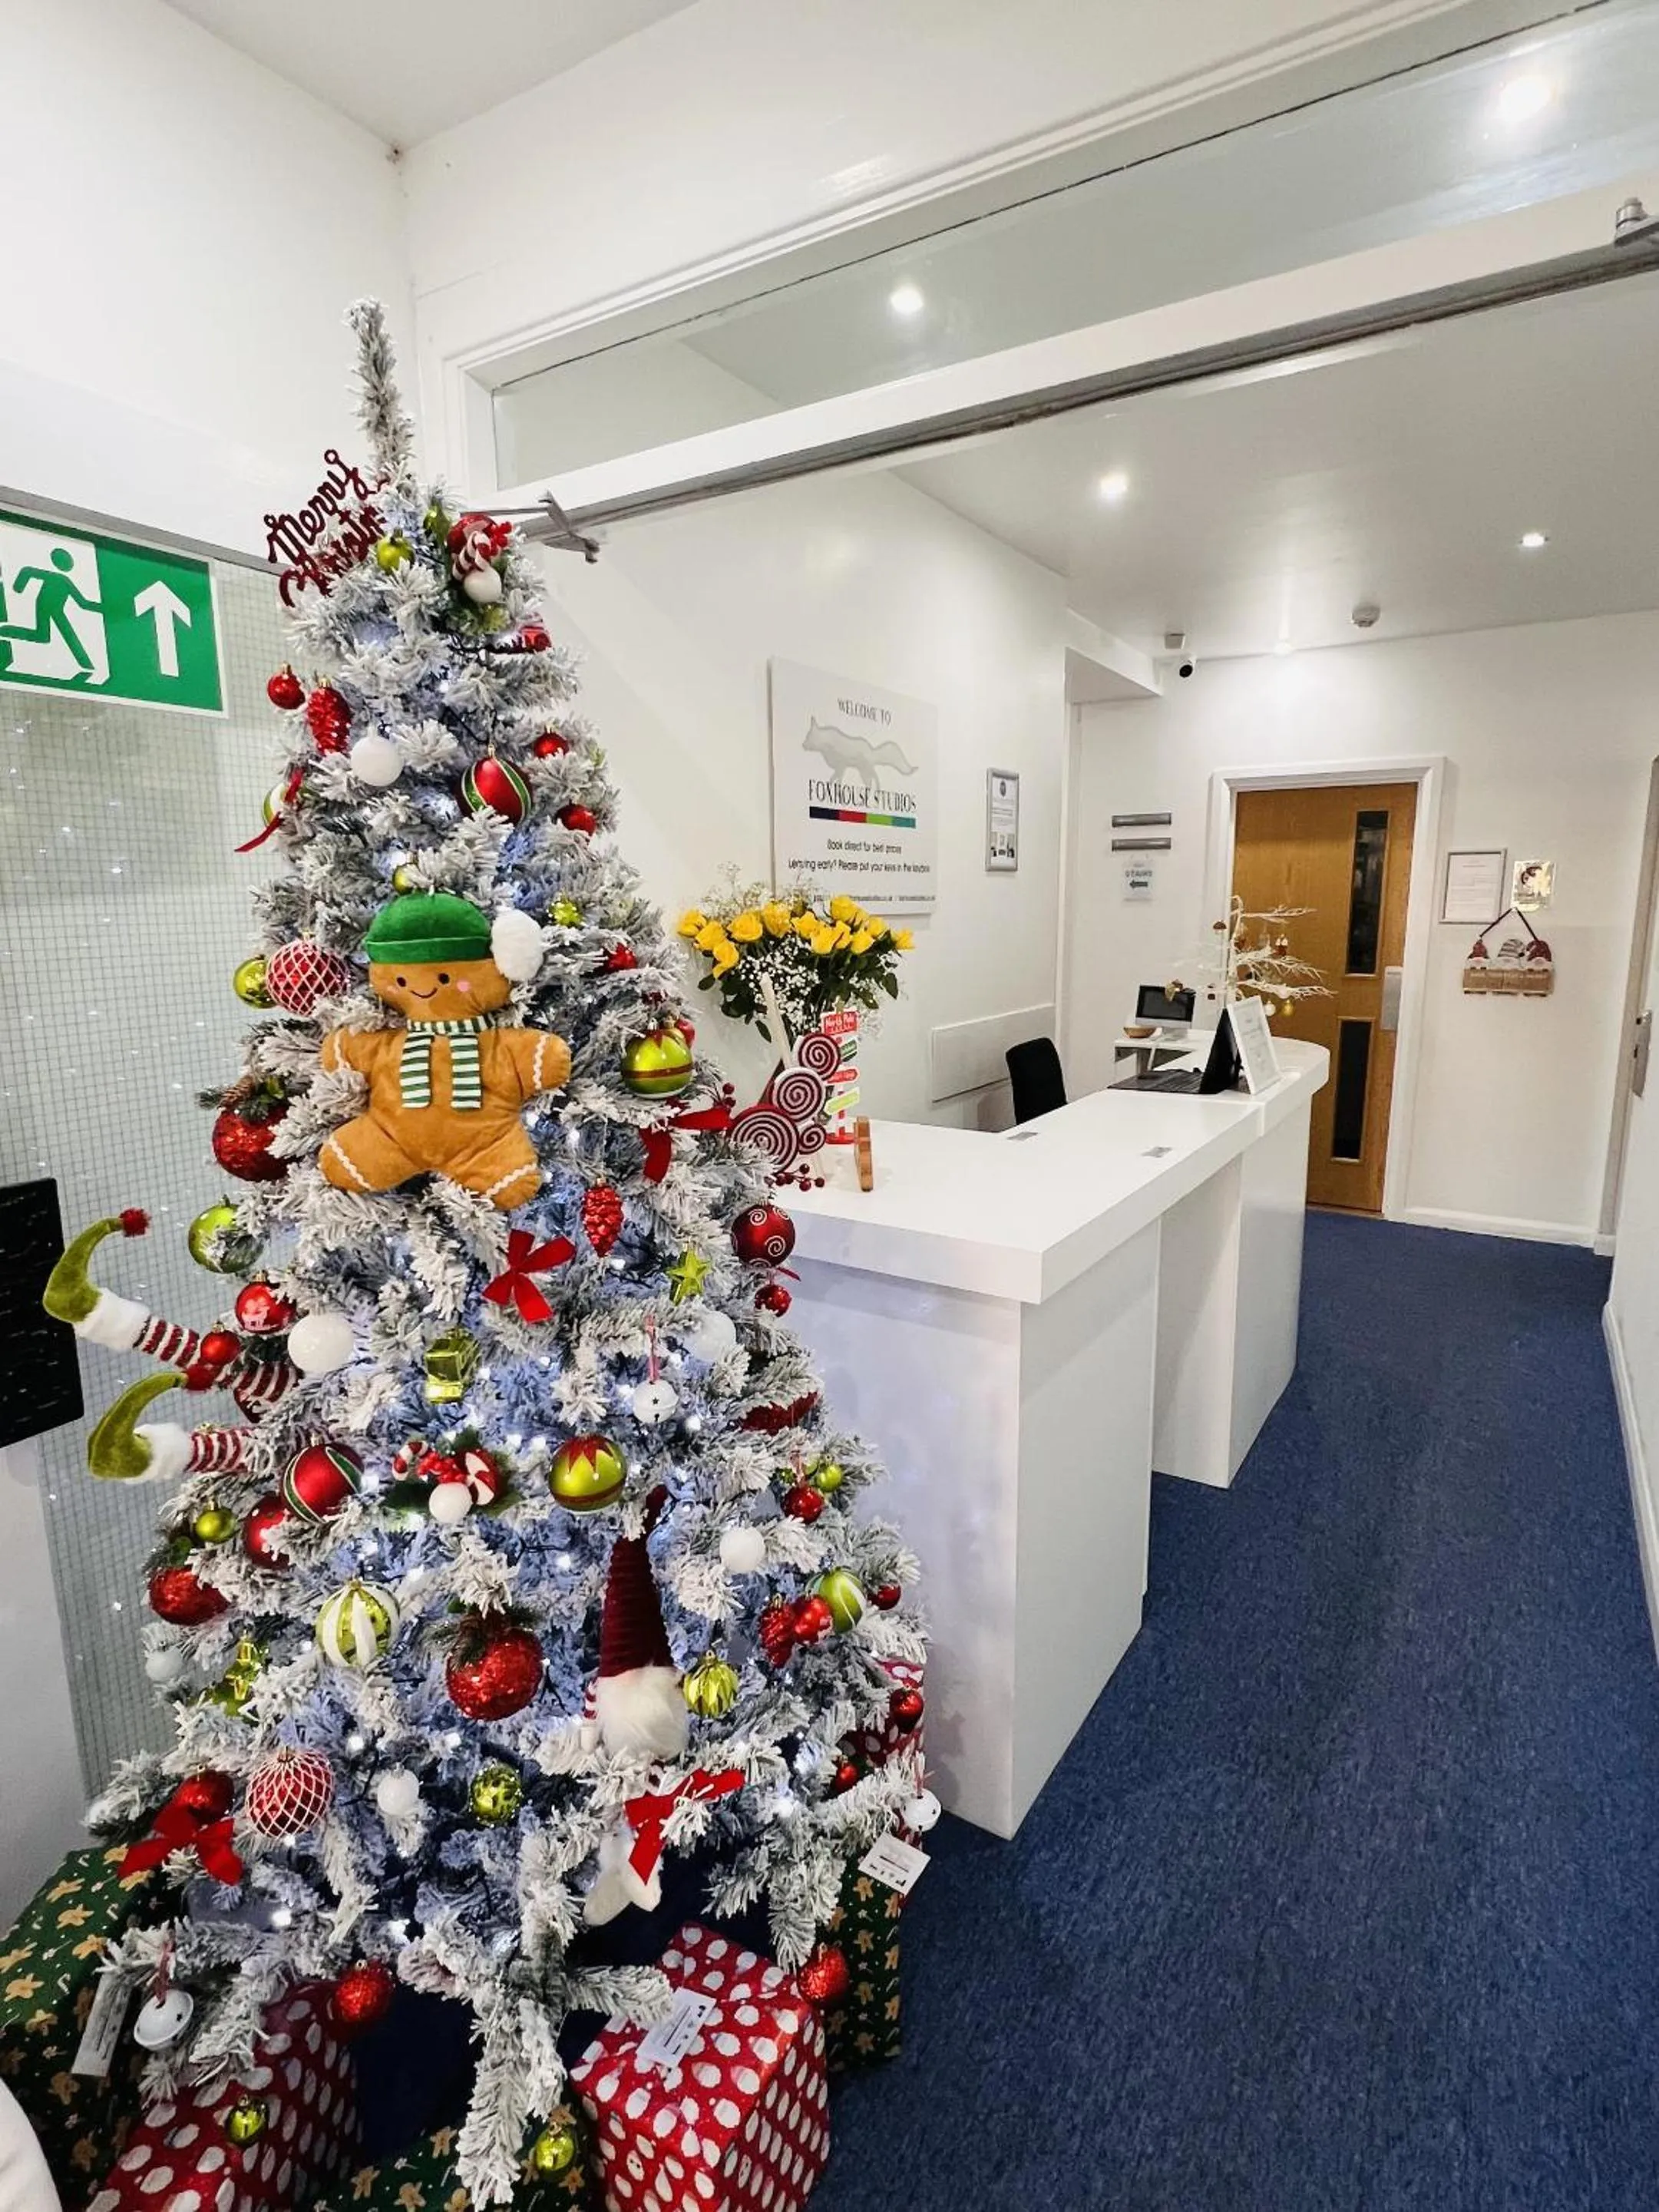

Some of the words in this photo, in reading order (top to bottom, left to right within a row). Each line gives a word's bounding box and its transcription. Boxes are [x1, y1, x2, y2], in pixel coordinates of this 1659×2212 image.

[837, 697, 877, 722] WELCOME
[880, 709, 891, 726] TO
[809, 779, 870, 808] FOXHOUSE
[874, 789, 917, 812] STUDIOS
